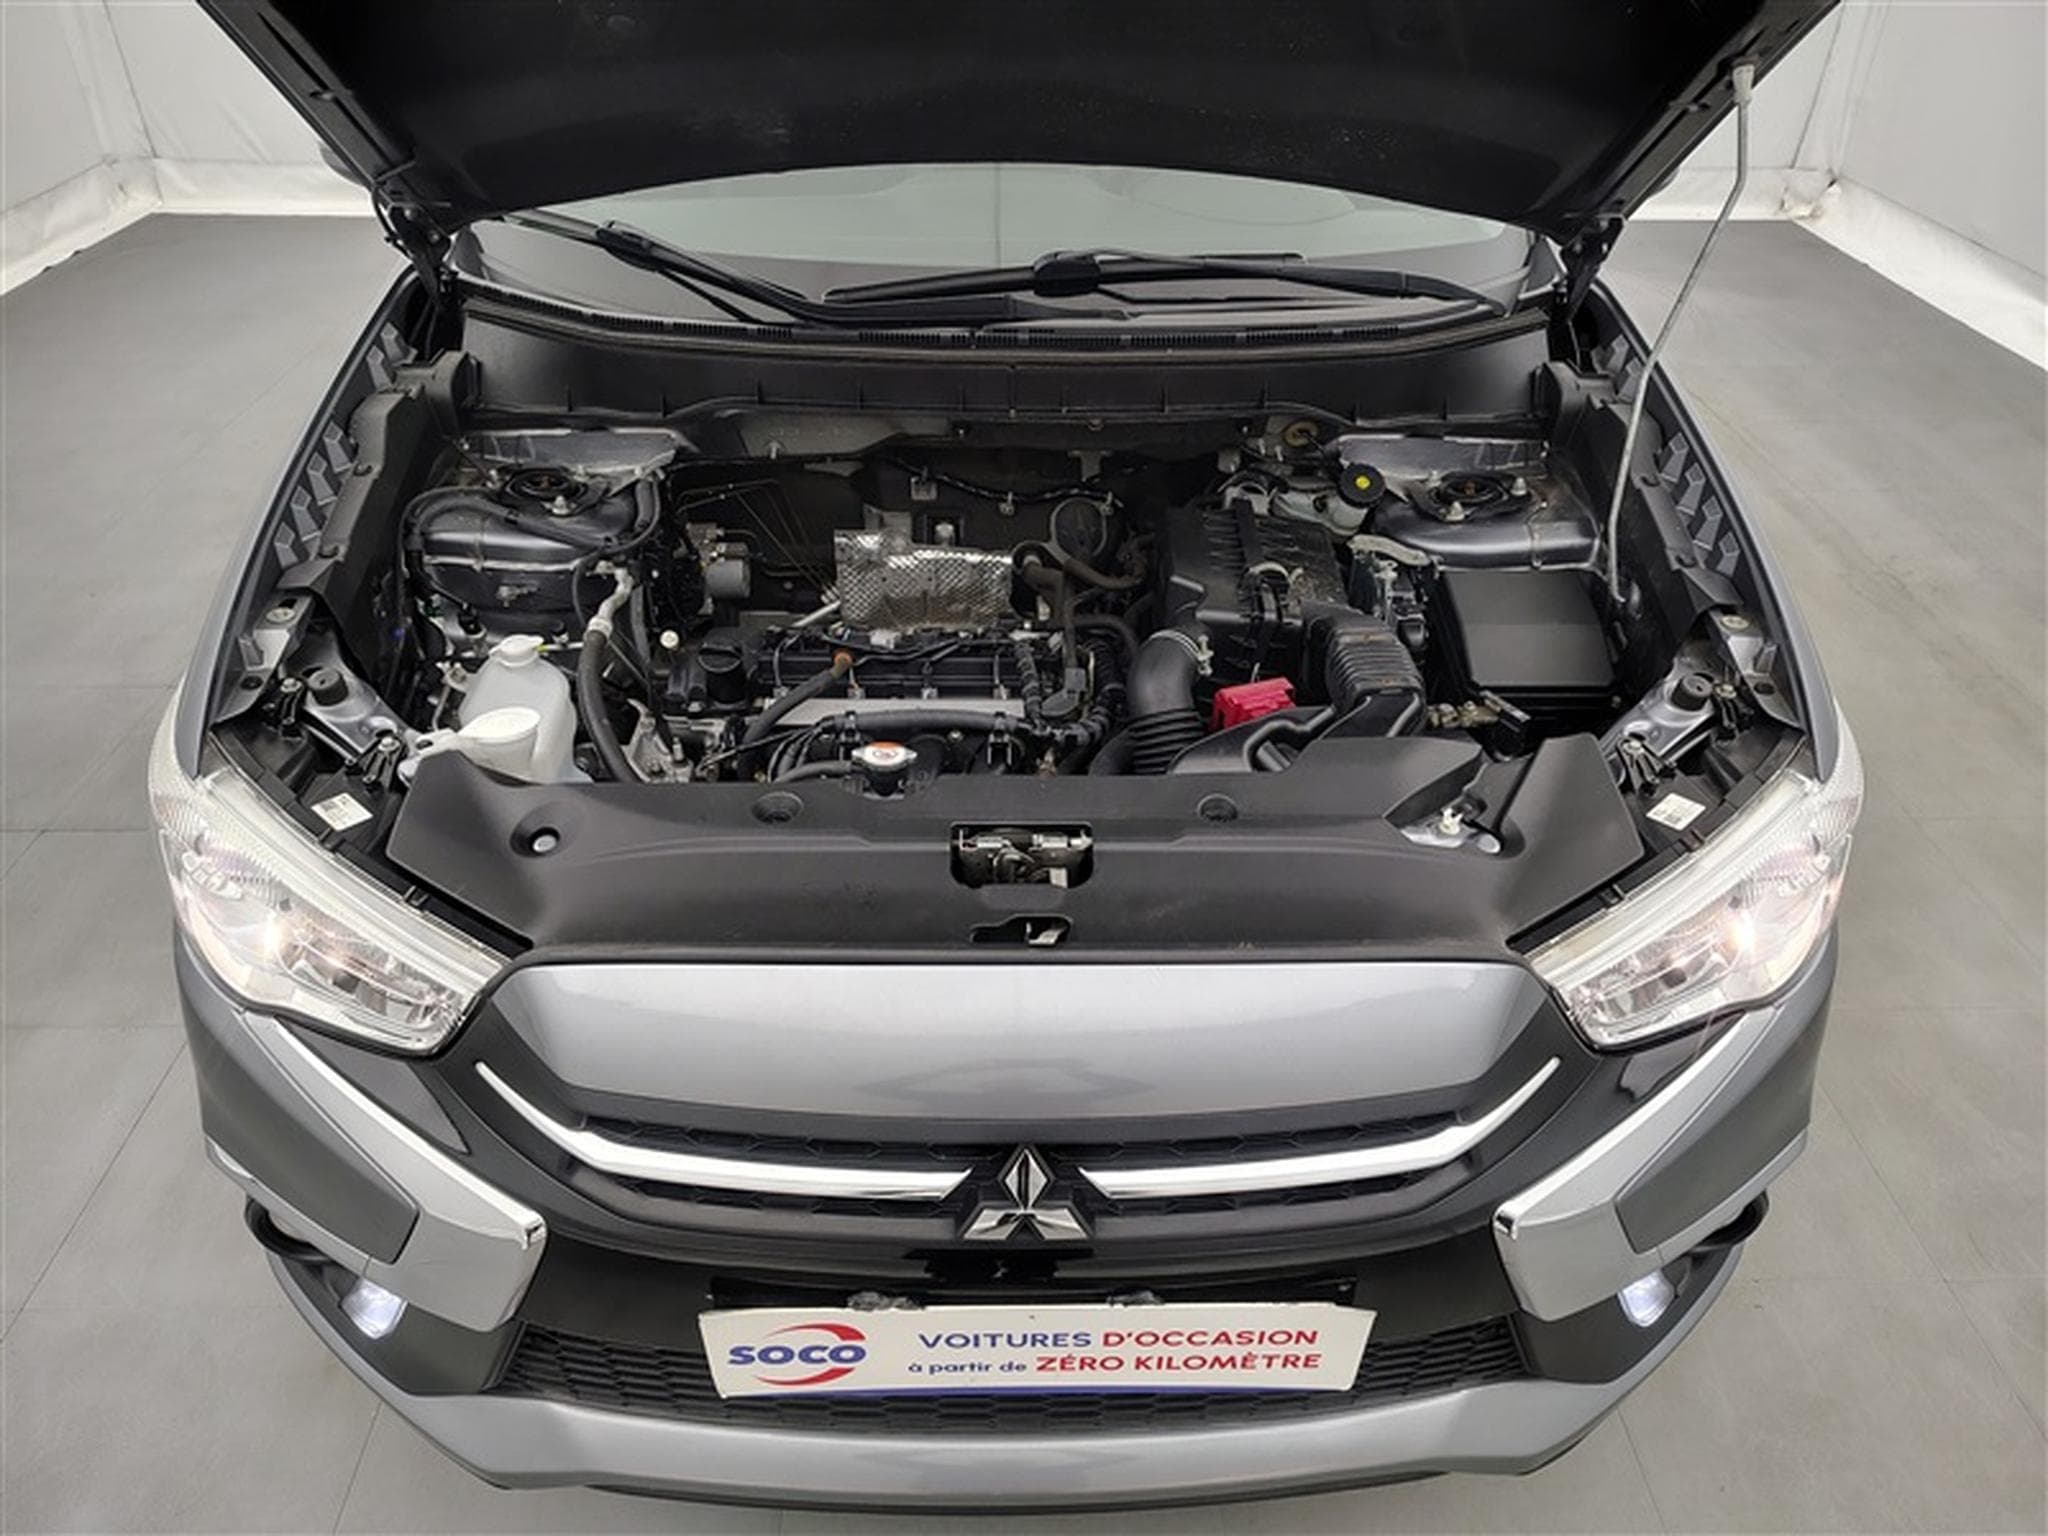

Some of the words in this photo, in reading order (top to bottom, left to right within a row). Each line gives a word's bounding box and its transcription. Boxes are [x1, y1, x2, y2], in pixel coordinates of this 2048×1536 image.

[918, 1332, 1091, 1348] VOITURES
[1102, 1330, 1319, 1348] D'OCCASION
[728, 1345, 867, 1365] SOCO
[908, 1361, 923, 1373] à
[928, 1361, 993, 1375] partir
[999, 1361, 1027, 1373] de
[1036, 1354, 1125, 1372] ZÉRO
[1134, 1352, 1322, 1371] KILOMÈTRE
